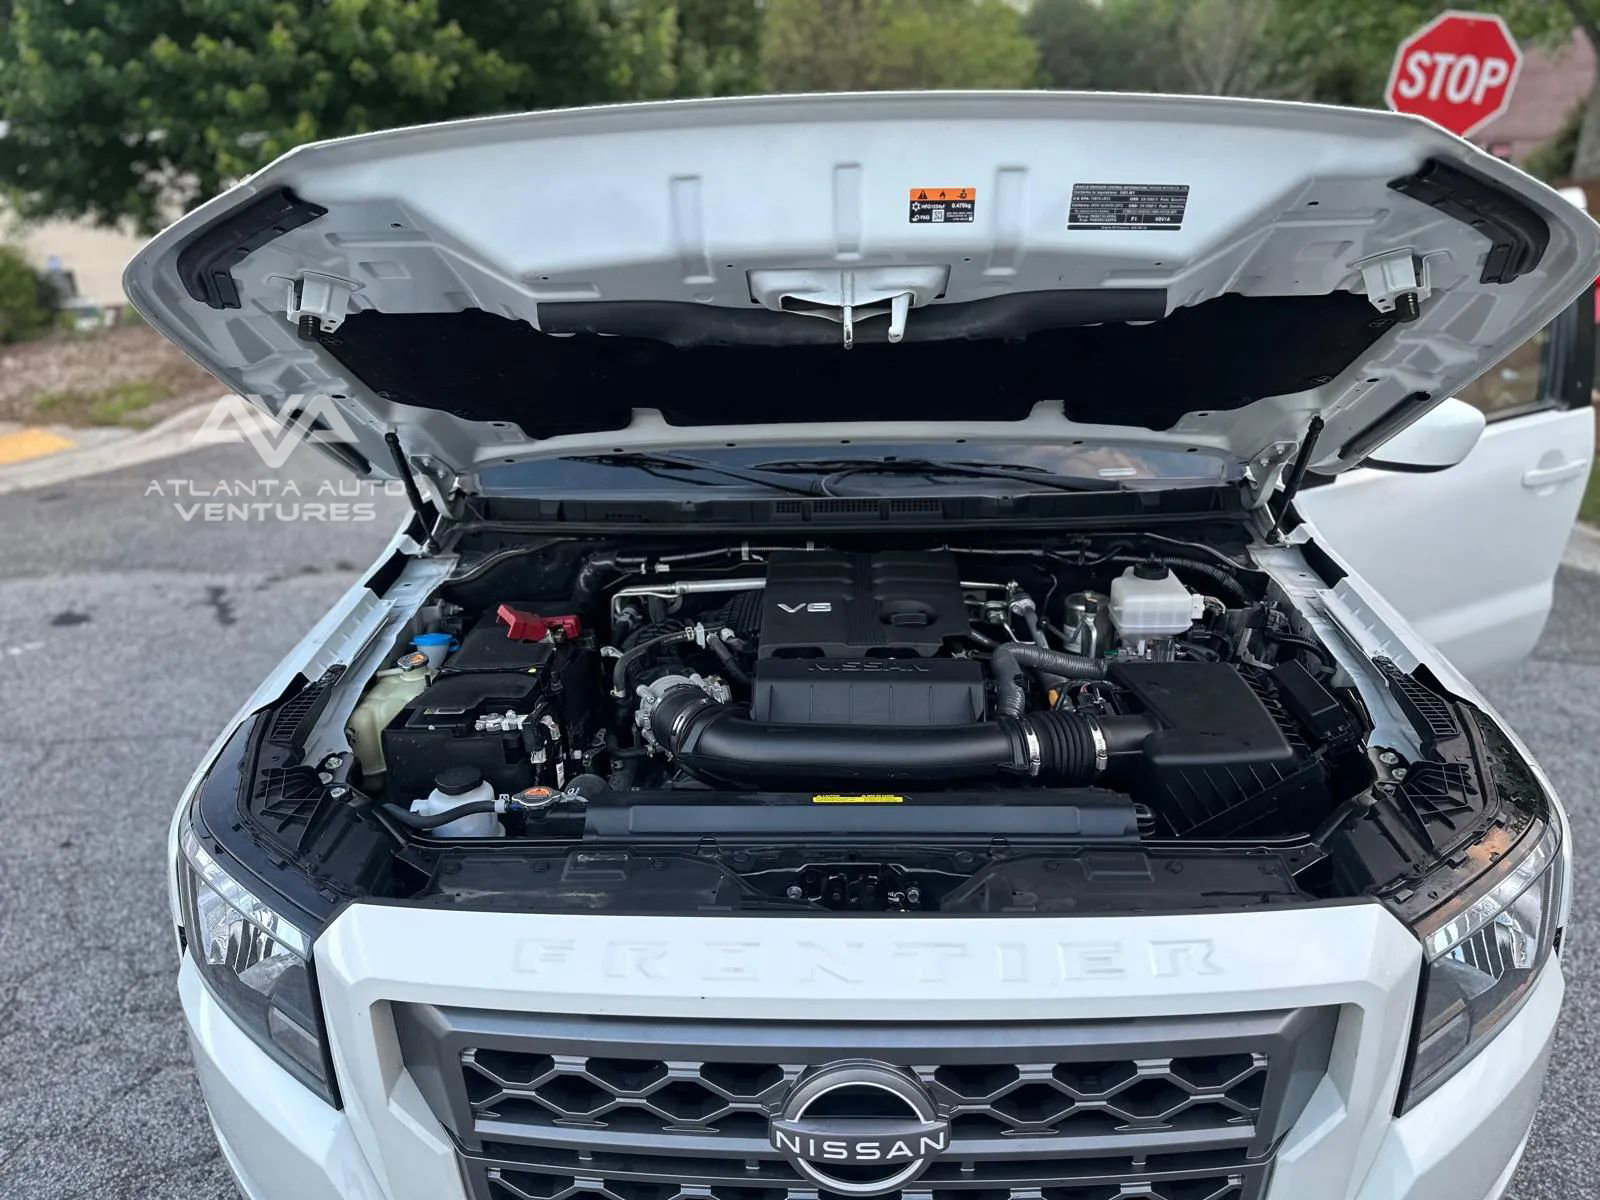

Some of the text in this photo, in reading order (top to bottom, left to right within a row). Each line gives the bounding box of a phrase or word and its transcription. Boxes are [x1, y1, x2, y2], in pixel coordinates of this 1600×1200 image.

[1398, 50, 1509, 105] STOP
[777, 602, 832, 613] V6
[808, 661, 931, 672] NISSAN
[512, 937, 1224, 983] FRONTIER
[775, 1130, 945, 1160] NISSAN
